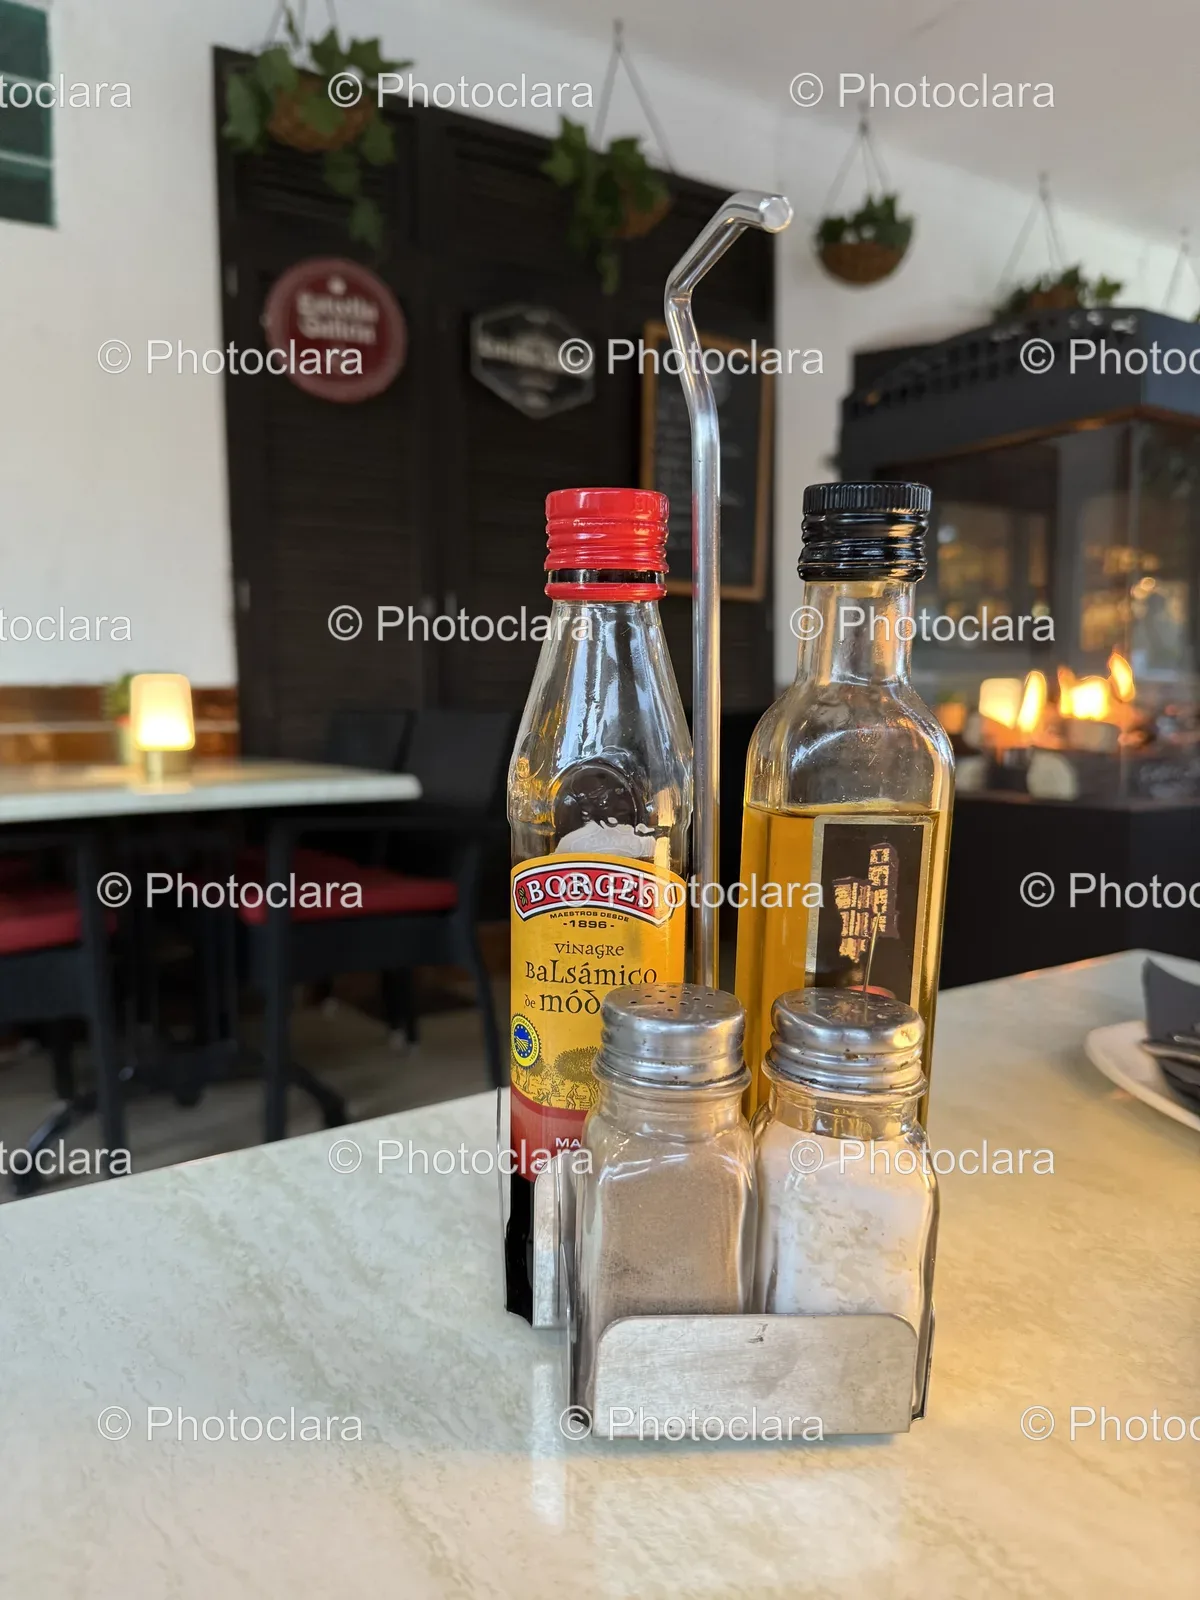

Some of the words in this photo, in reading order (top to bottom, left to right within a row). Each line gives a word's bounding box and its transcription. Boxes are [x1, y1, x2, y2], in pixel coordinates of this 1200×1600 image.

[527, 873, 656, 909] BORGES
[550, 911, 598, 919] MAESTROS
[600, 912, 629, 922] DESDE
[524, 994, 536, 1008] de
[539, 989, 601, 1015] mód
[555, 1137, 582, 1148] MA
